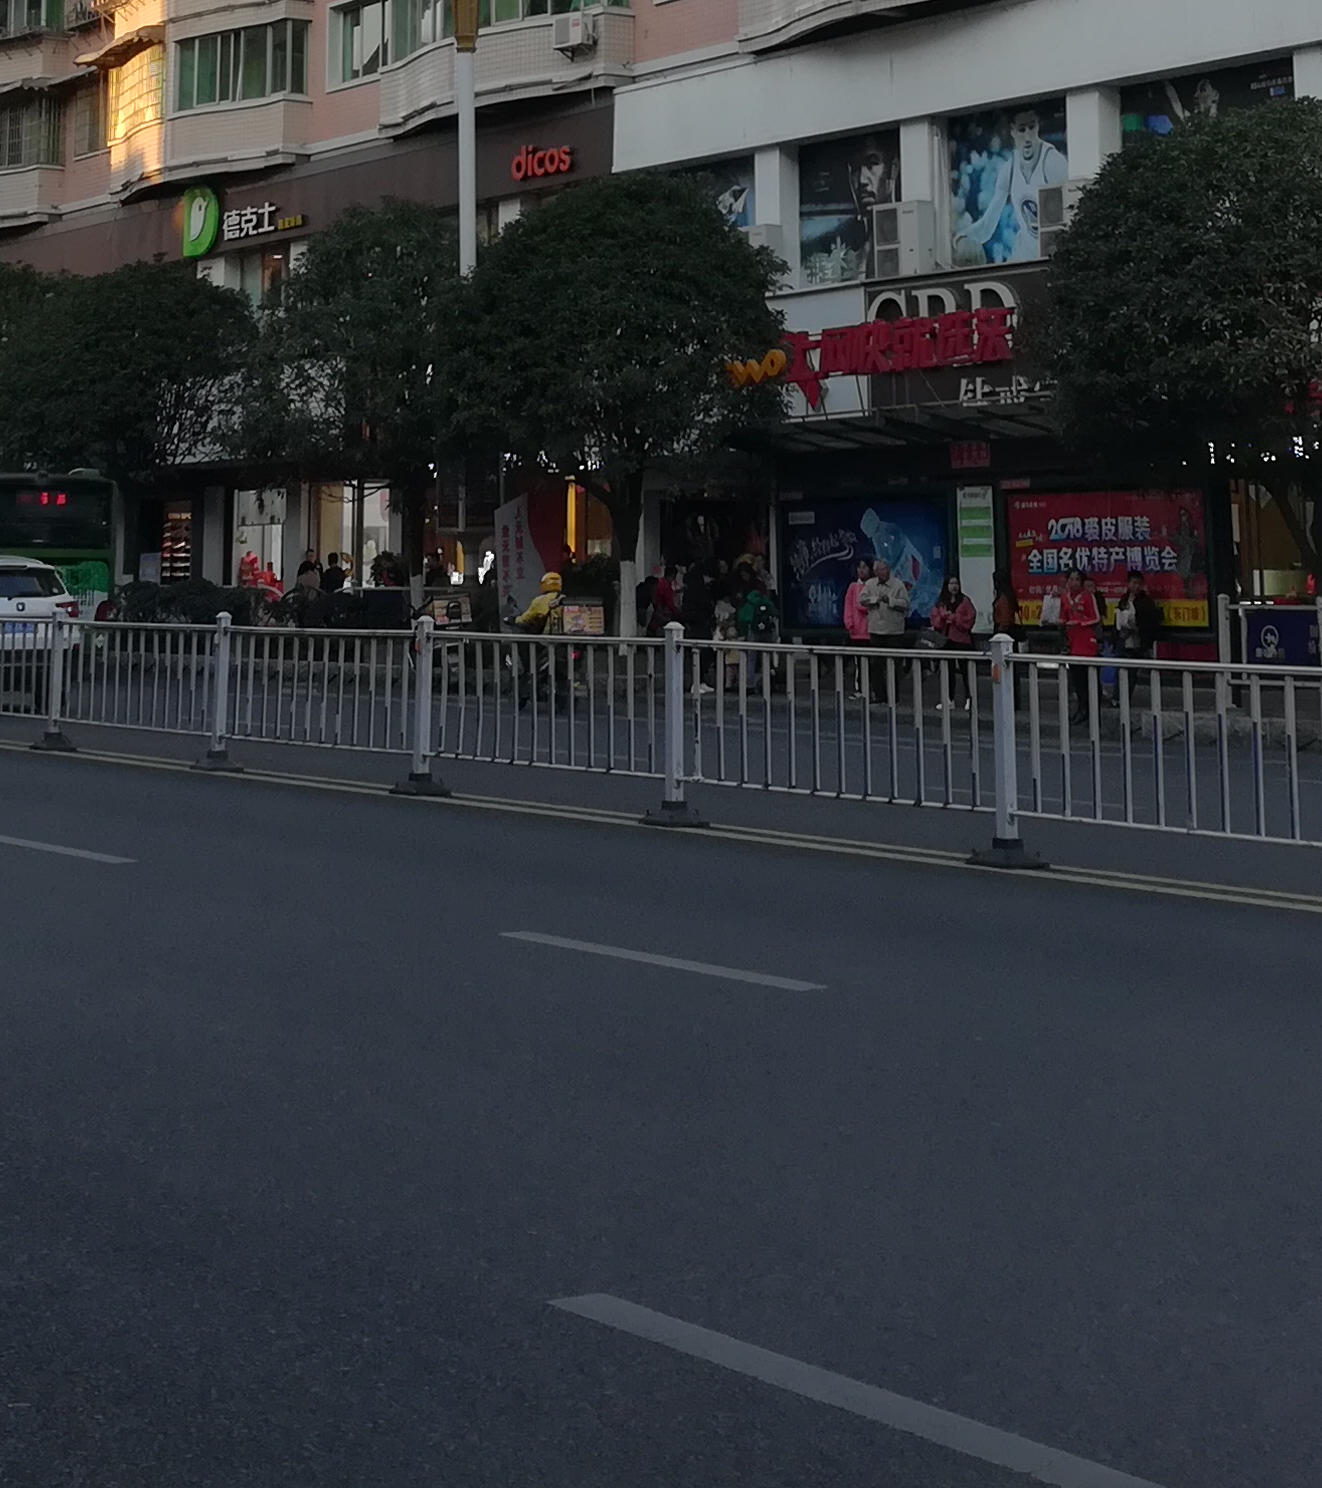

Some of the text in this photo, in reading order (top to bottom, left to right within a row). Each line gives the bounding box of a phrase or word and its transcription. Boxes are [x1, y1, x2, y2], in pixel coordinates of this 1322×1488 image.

[511, 144, 571, 181] dicos
[223, 202, 277, 240] 德克士
[1027, 546, 1178, 574] 全国名优特产博览会
